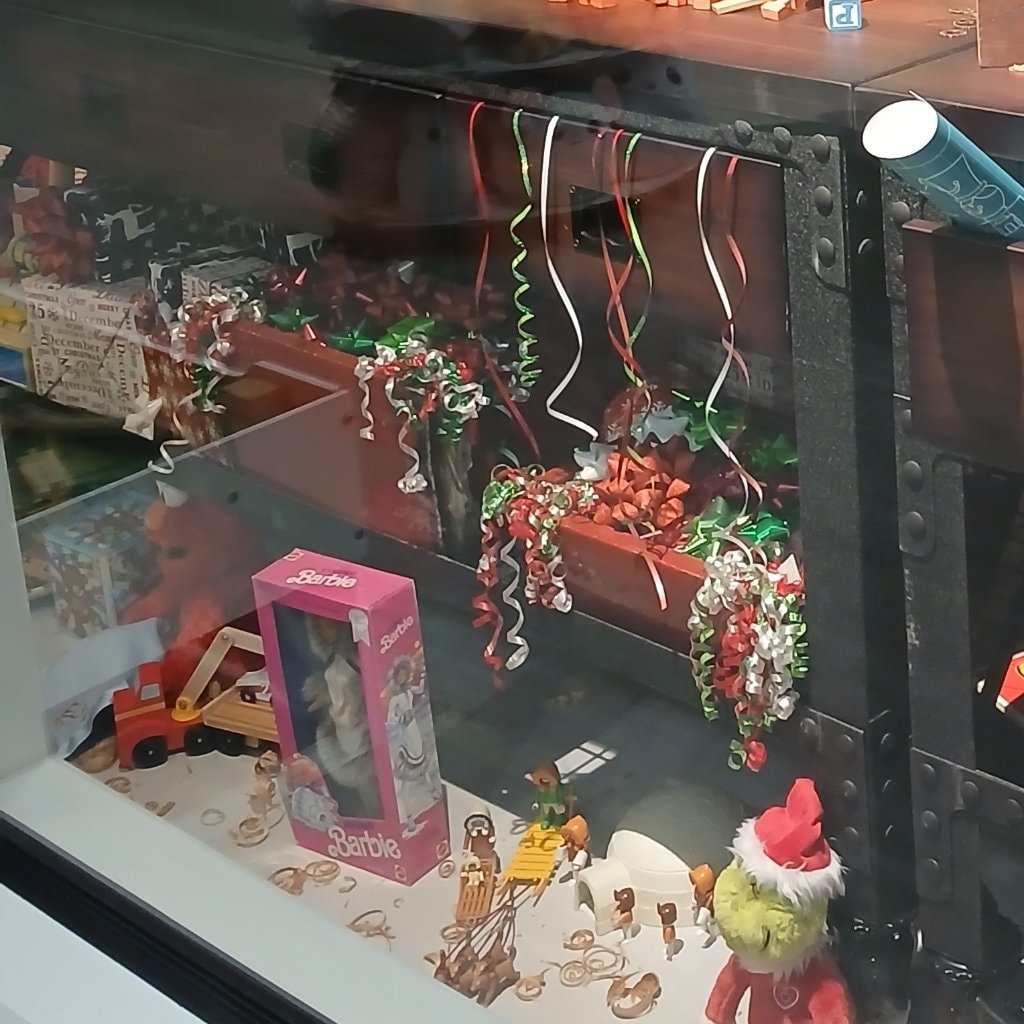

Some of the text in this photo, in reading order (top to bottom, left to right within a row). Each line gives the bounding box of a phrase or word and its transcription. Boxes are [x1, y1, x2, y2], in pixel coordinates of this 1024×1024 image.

[835, 4, 855, 25] P
[286, 569, 358, 588] Barbie
[380, 615, 414, 655] Barbie
[328, 825, 402, 860] Barbie
